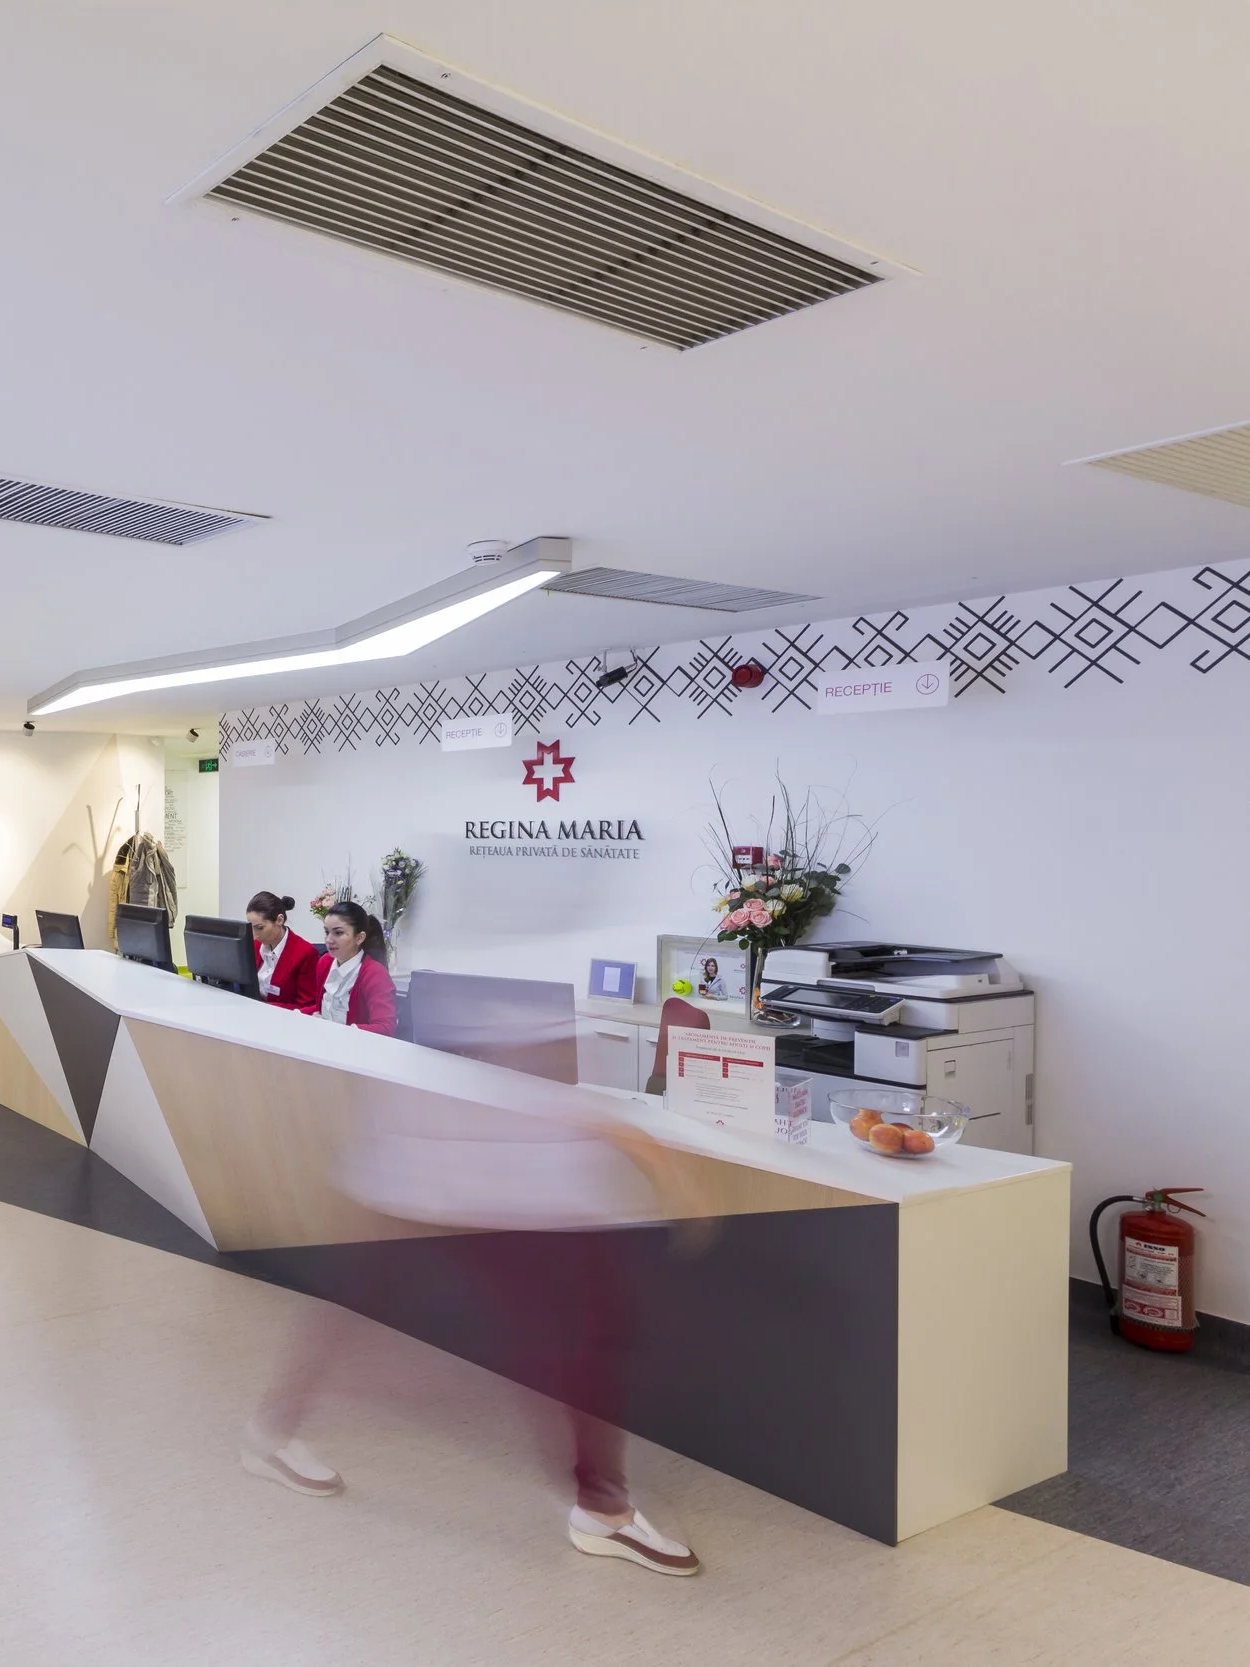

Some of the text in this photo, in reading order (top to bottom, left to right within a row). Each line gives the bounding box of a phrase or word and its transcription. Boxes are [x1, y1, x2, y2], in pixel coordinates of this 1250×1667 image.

[464, 819, 644, 840] REGINA MARIA
[469, 844, 640, 859] REȚEAUA PRIVATĂ DE SĂNĂTATE
